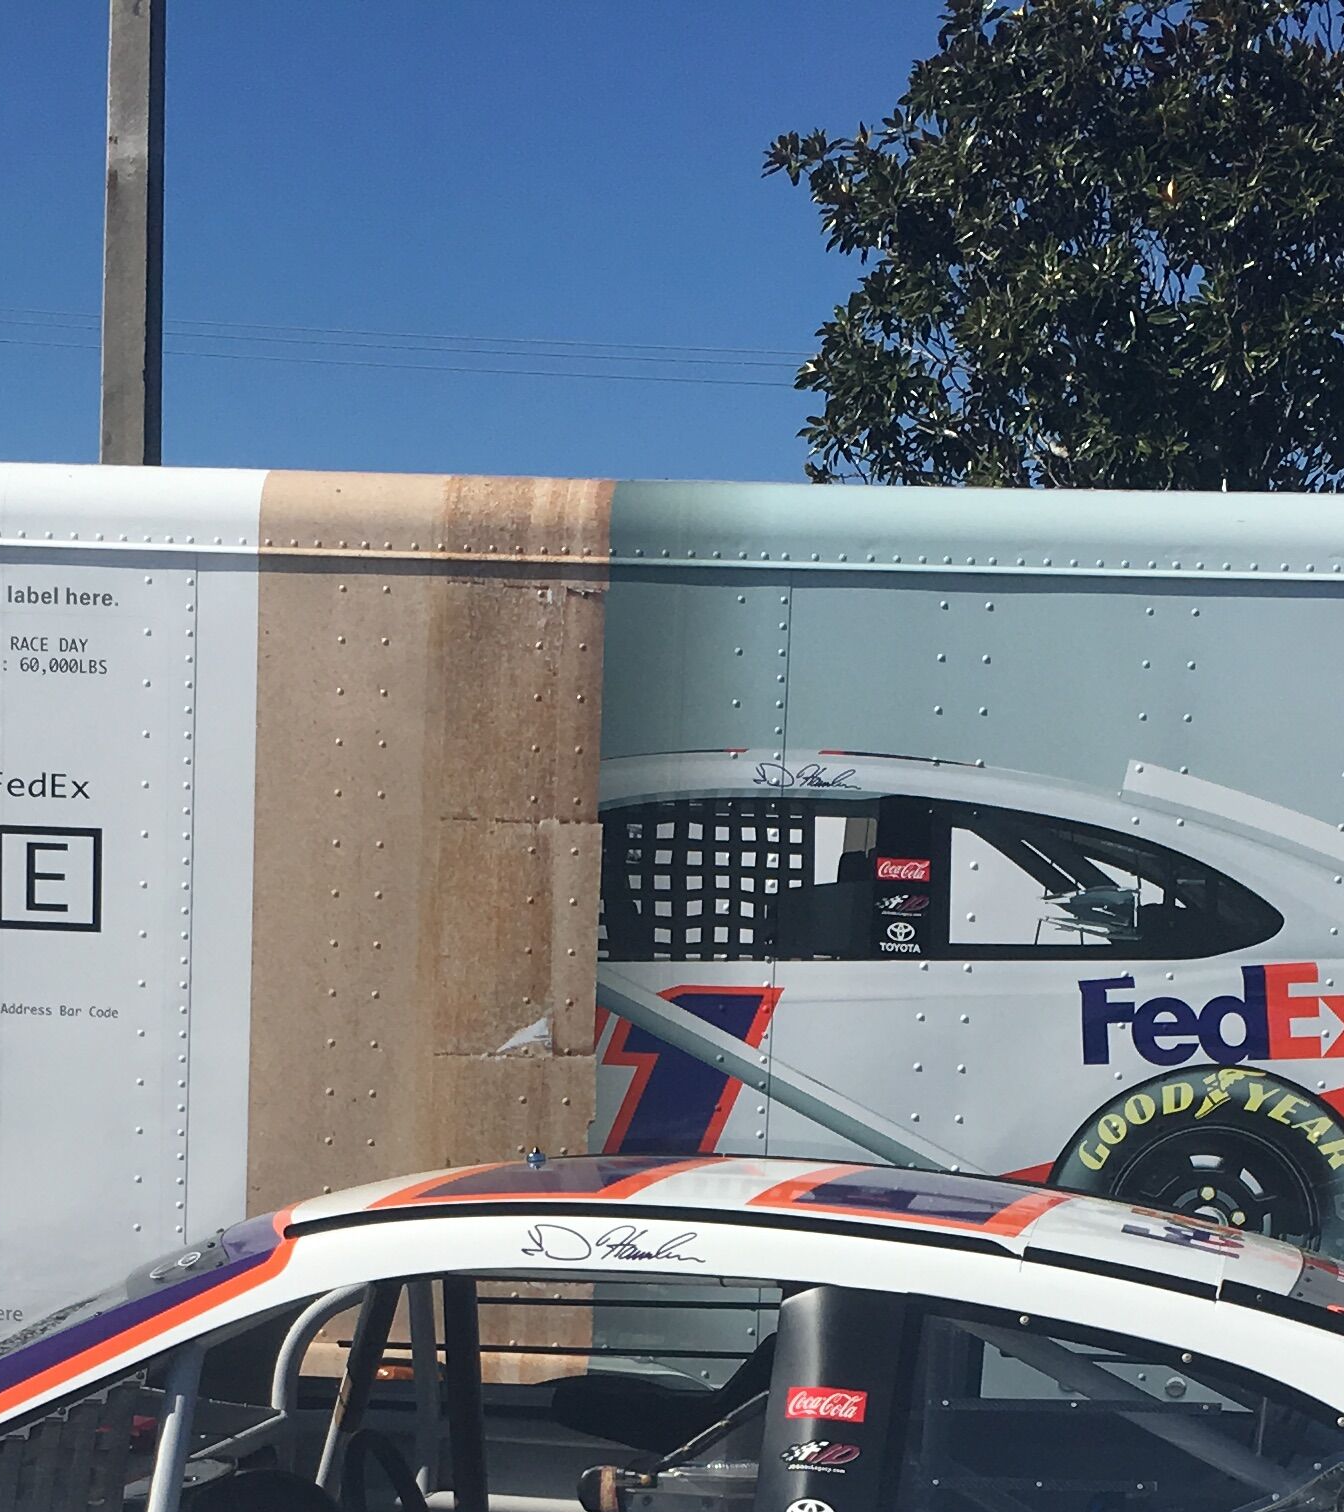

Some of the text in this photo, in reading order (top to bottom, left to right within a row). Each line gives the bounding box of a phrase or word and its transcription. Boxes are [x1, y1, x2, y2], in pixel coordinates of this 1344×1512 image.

[8, 586, 58, 605] label
[66, 588, 118, 606] here.
[11, 637, 49, 651] RACE
[59, 638, 88, 652] DAY
[20, 658, 107, 675] 60,000LBS
[26, 841, 69, 913] E
[879, 941, 921, 954] TOYOTA
[1, 1003, 52, 1015] Address
[60, 1005, 82, 1017] Bar
[89, 1006, 118, 1018] Code
